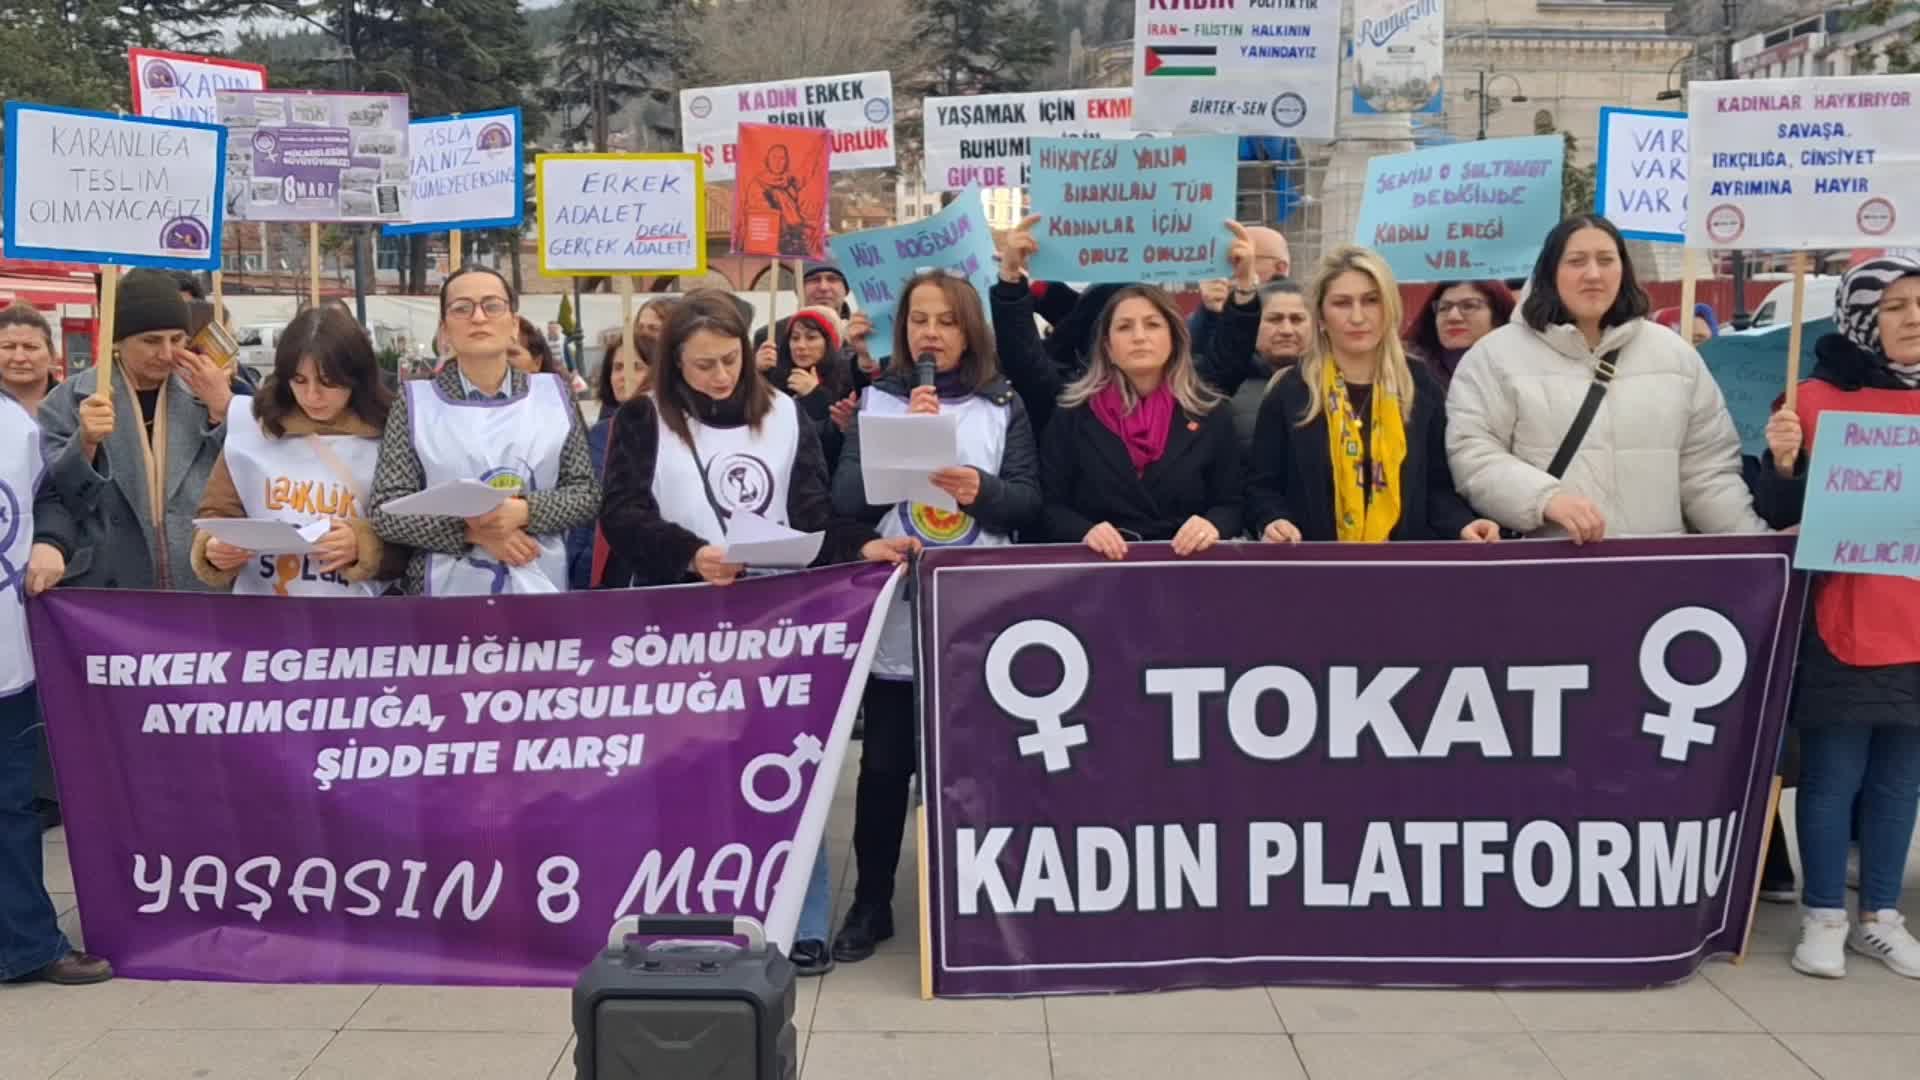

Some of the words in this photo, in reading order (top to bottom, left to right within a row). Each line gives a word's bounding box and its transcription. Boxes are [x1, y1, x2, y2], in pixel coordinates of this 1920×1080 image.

[1251, 24, 1311, 37] HALKININ
[1240, 45, 1317, 59] YANINDAYIZ
[738, 87, 798, 112] KADIN
[805, 80, 864, 105] ERKEK
[1190, 97, 1267, 115] BİRTEK-SEN
[1717, 95, 1802, 113] KADINLAR
[1814, 91, 1911, 110] HAYKIRIYOR
[937, 103, 1026, 128] YAŞAMAK
[1039, 97, 1075, 125] İÇİN
[51, 125, 191, 158] KARANLIĞA
[1801, 146, 1876, 167] CİNSİYET
[284, 175, 296, 203] 8
[296, 181, 335, 197] MART
[581, 171, 681, 194] ERKEK
[1063, 180, 1157, 203] BIRAKILAN
[1170, 180, 1214, 202] TÜM
[1376, 161, 1433, 195] SENİN
[1439, 163, 1452, 180] O
[1710, 178, 1793, 197] AYRIMINA
[1813, 177, 1870, 195] HAYIR
[555, 202, 647, 224] ADALET
[1618, 187, 1671, 213] VAR
[1048, 215, 1135, 237] KADINLAR
[1151, 208, 1193, 236] İÇİN
[1373, 221, 1430, 246] KADIN
[1446, 215, 1504, 241] EMEĞİ
[549, 237, 619, 257] GERÇEK
[1078, 247, 1129, 267] OMUZ
[86, 651, 232, 687] ERKEK
[242, 634, 595, 684] EGEMENLİĞİNE,
[608, 618, 861, 668] SÖMÜRÜYE,
[142, 685, 446, 734] AYRIMCILIĞA,
[461, 671, 746, 724] YOKSULLUĞA
[757, 673, 813, 708] VE
[1145, 664, 1590, 762] TOKAT
[313, 738, 501, 791] ŞİDDETE
[513, 733, 646, 777] KARŞI
[956, 823, 1218, 916] KADIN
[1249, 810, 1738, 909] PLATFORMU
[131, 853, 504, 922] YAŞASIN
[536, 855, 581, 924] 8
